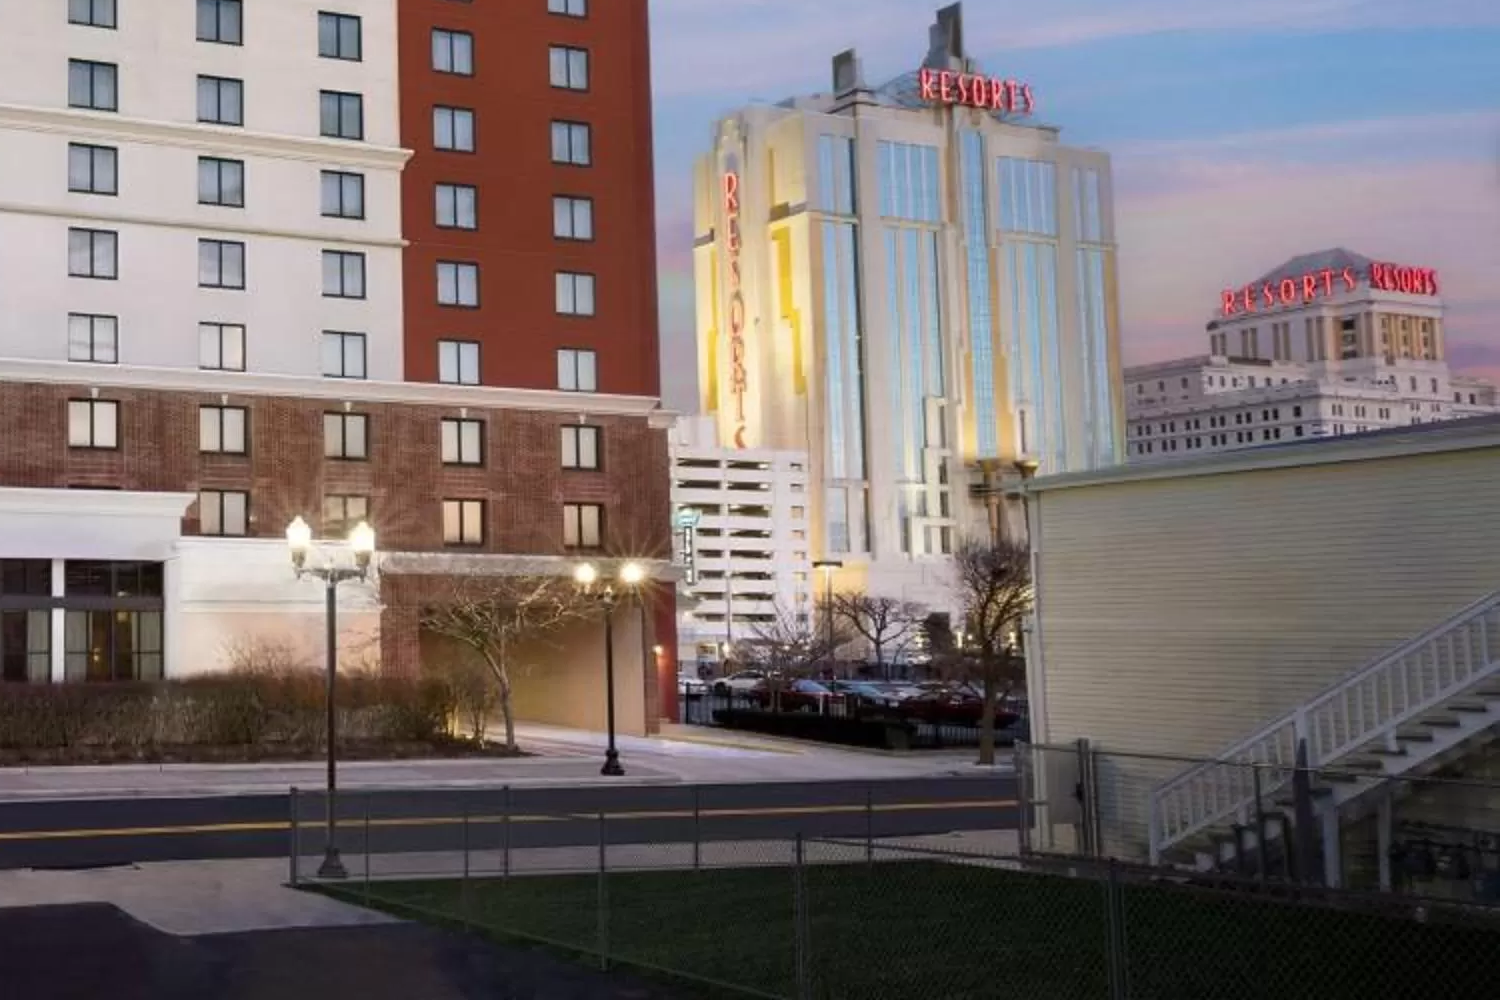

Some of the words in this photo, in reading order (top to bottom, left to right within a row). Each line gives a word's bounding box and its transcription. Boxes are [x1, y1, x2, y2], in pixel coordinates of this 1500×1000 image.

[919, 68, 1035, 116] RESORTS
[1221, 267, 1357, 318] RESORTS
[1368, 262, 1438, 296] RESORTS
